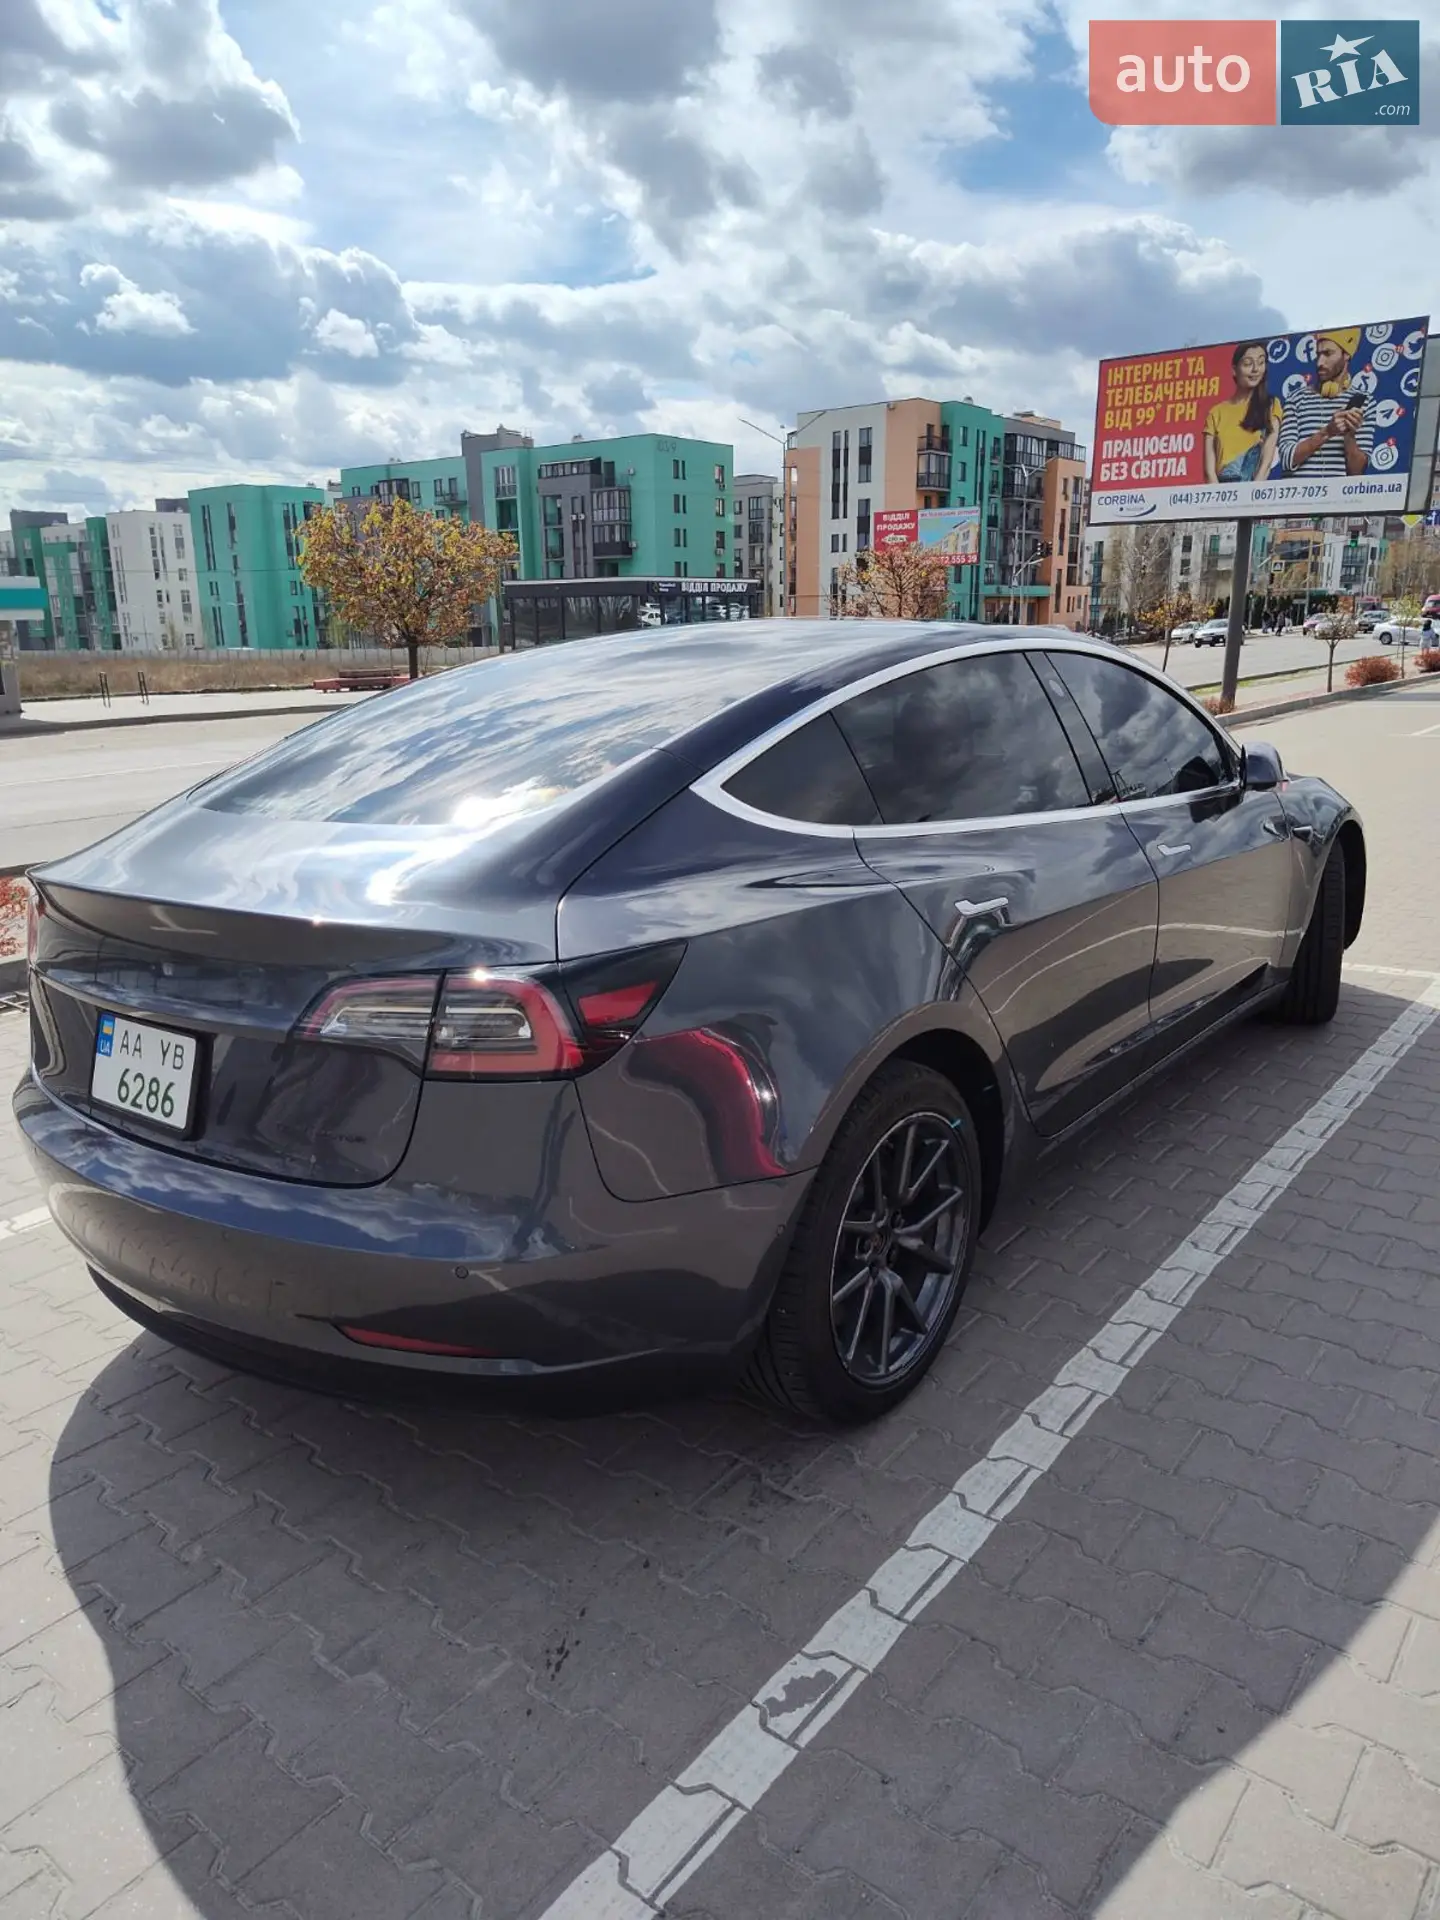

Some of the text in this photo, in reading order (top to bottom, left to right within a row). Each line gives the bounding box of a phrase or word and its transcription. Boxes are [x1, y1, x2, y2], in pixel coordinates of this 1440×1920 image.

[1107, 356, 1205, 387] ІНТЕРНЕТ ТА
[1106, 376, 1220, 407] ТЕЛЕБАЧЕННЯ
[1103, 408, 1132, 431] ВІД
[1165, 401, 1198, 423] ГРН
[1102, 433, 1195, 459] ПРАЦЮЄМО
[1100, 456, 1187, 482] БЕЗ СВІТЛА
[1342, 481, 1402, 495] corbina.ua
[876, 522, 916, 532] ПРОДАЖУ
[882, 512, 910, 522] ВІДДІЛ
[681, 582, 708, 593] ВІДДІЛ
[710, 582, 748, 593] ПРОДАЖУ
[100, 1039, 110, 1053] UA
[120, 1030, 184, 1070] AA YB
[117, 1068, 175, 1118] 6286
